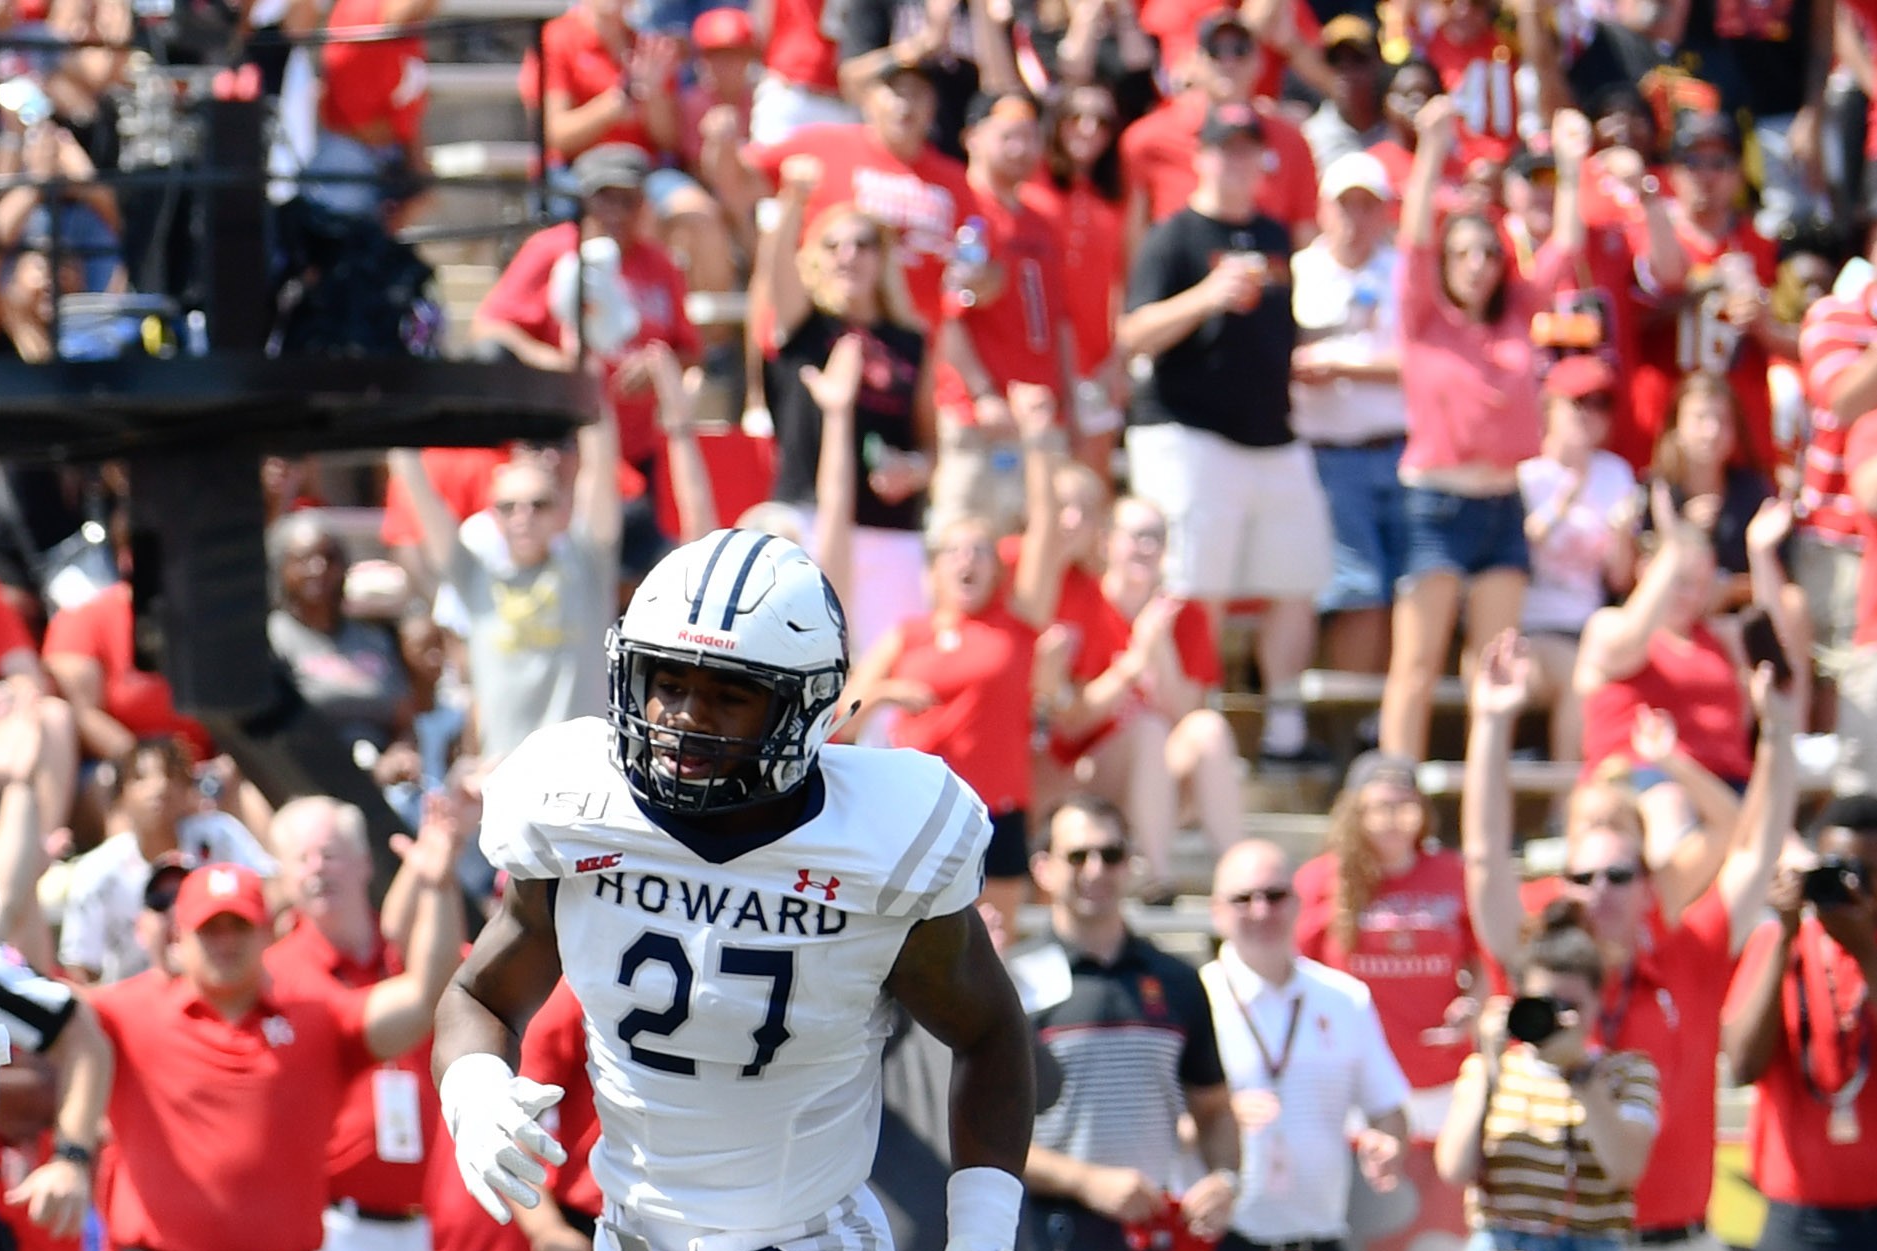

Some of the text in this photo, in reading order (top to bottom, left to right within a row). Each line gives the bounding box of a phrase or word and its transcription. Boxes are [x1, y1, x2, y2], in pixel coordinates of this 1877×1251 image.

[677, 629, 737, 650] Riddell
[575, 852, 623, 873] MEAC
[595, 871, 847, 936] HOWARD
[614, 926, 800, 1079] 27
